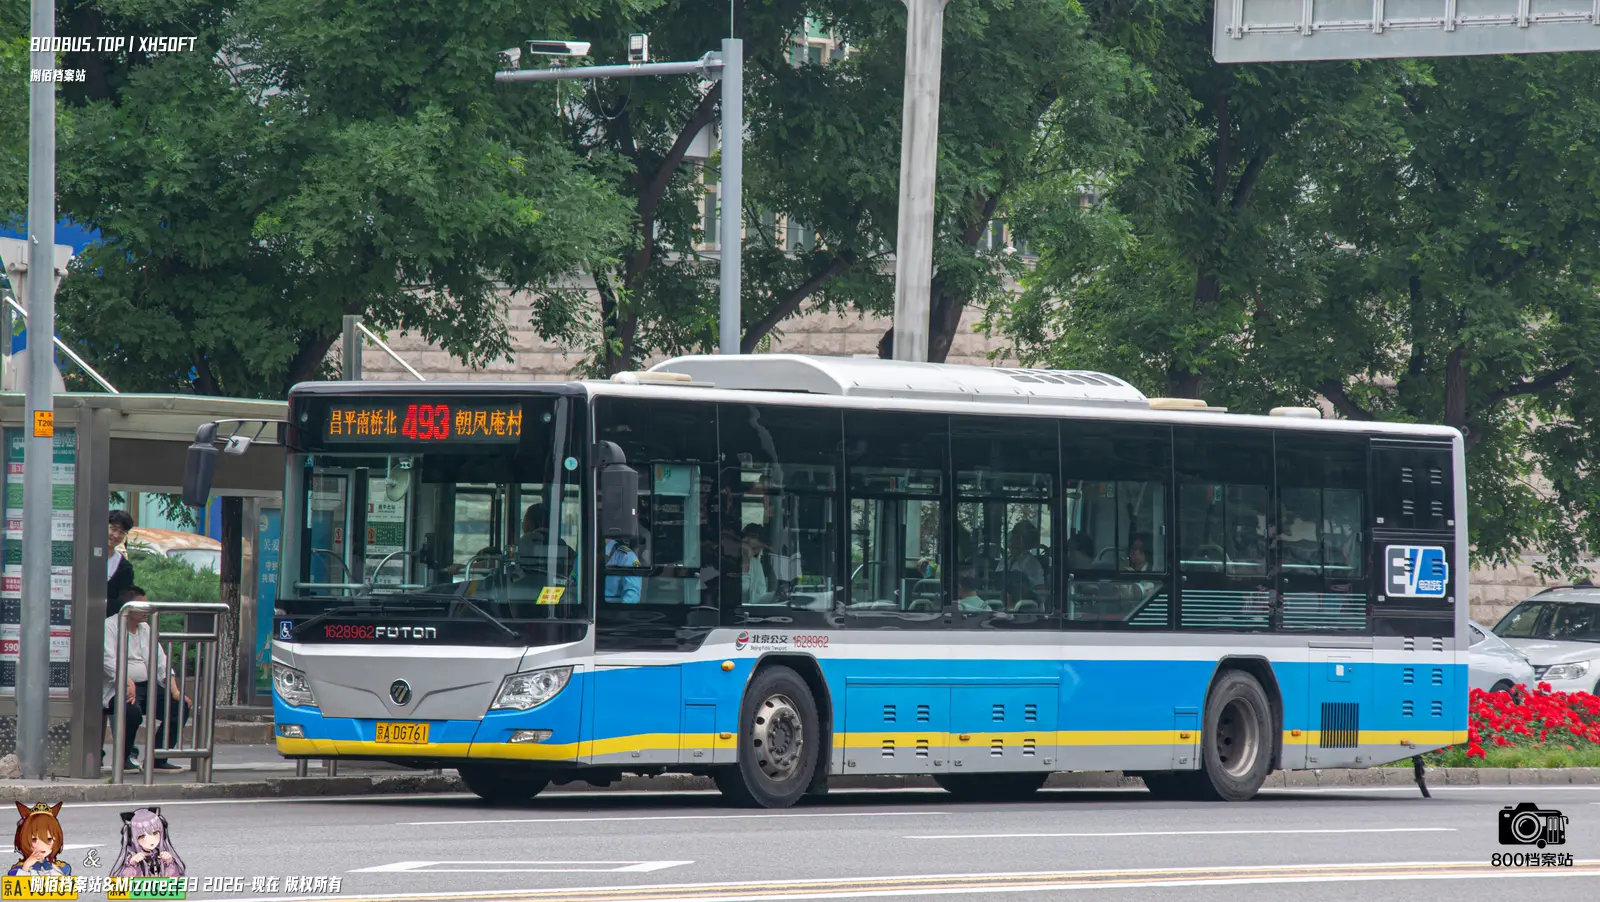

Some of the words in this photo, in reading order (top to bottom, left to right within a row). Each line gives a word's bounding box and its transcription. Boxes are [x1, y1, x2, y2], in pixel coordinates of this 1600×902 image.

[329, 409, 397, 435] 昌平南桥北
[402, 404, 450, 440] 493
[455, 409, 523, 436] 朝凤庵村
[324, 625, 374, 639] 1628962
[375, 626, 437, 639] FOTON
[4, 643, 19, 652] 590
[751, 634, 788, 644] 北京公交
[793, 635, 829, 648] 1628962
